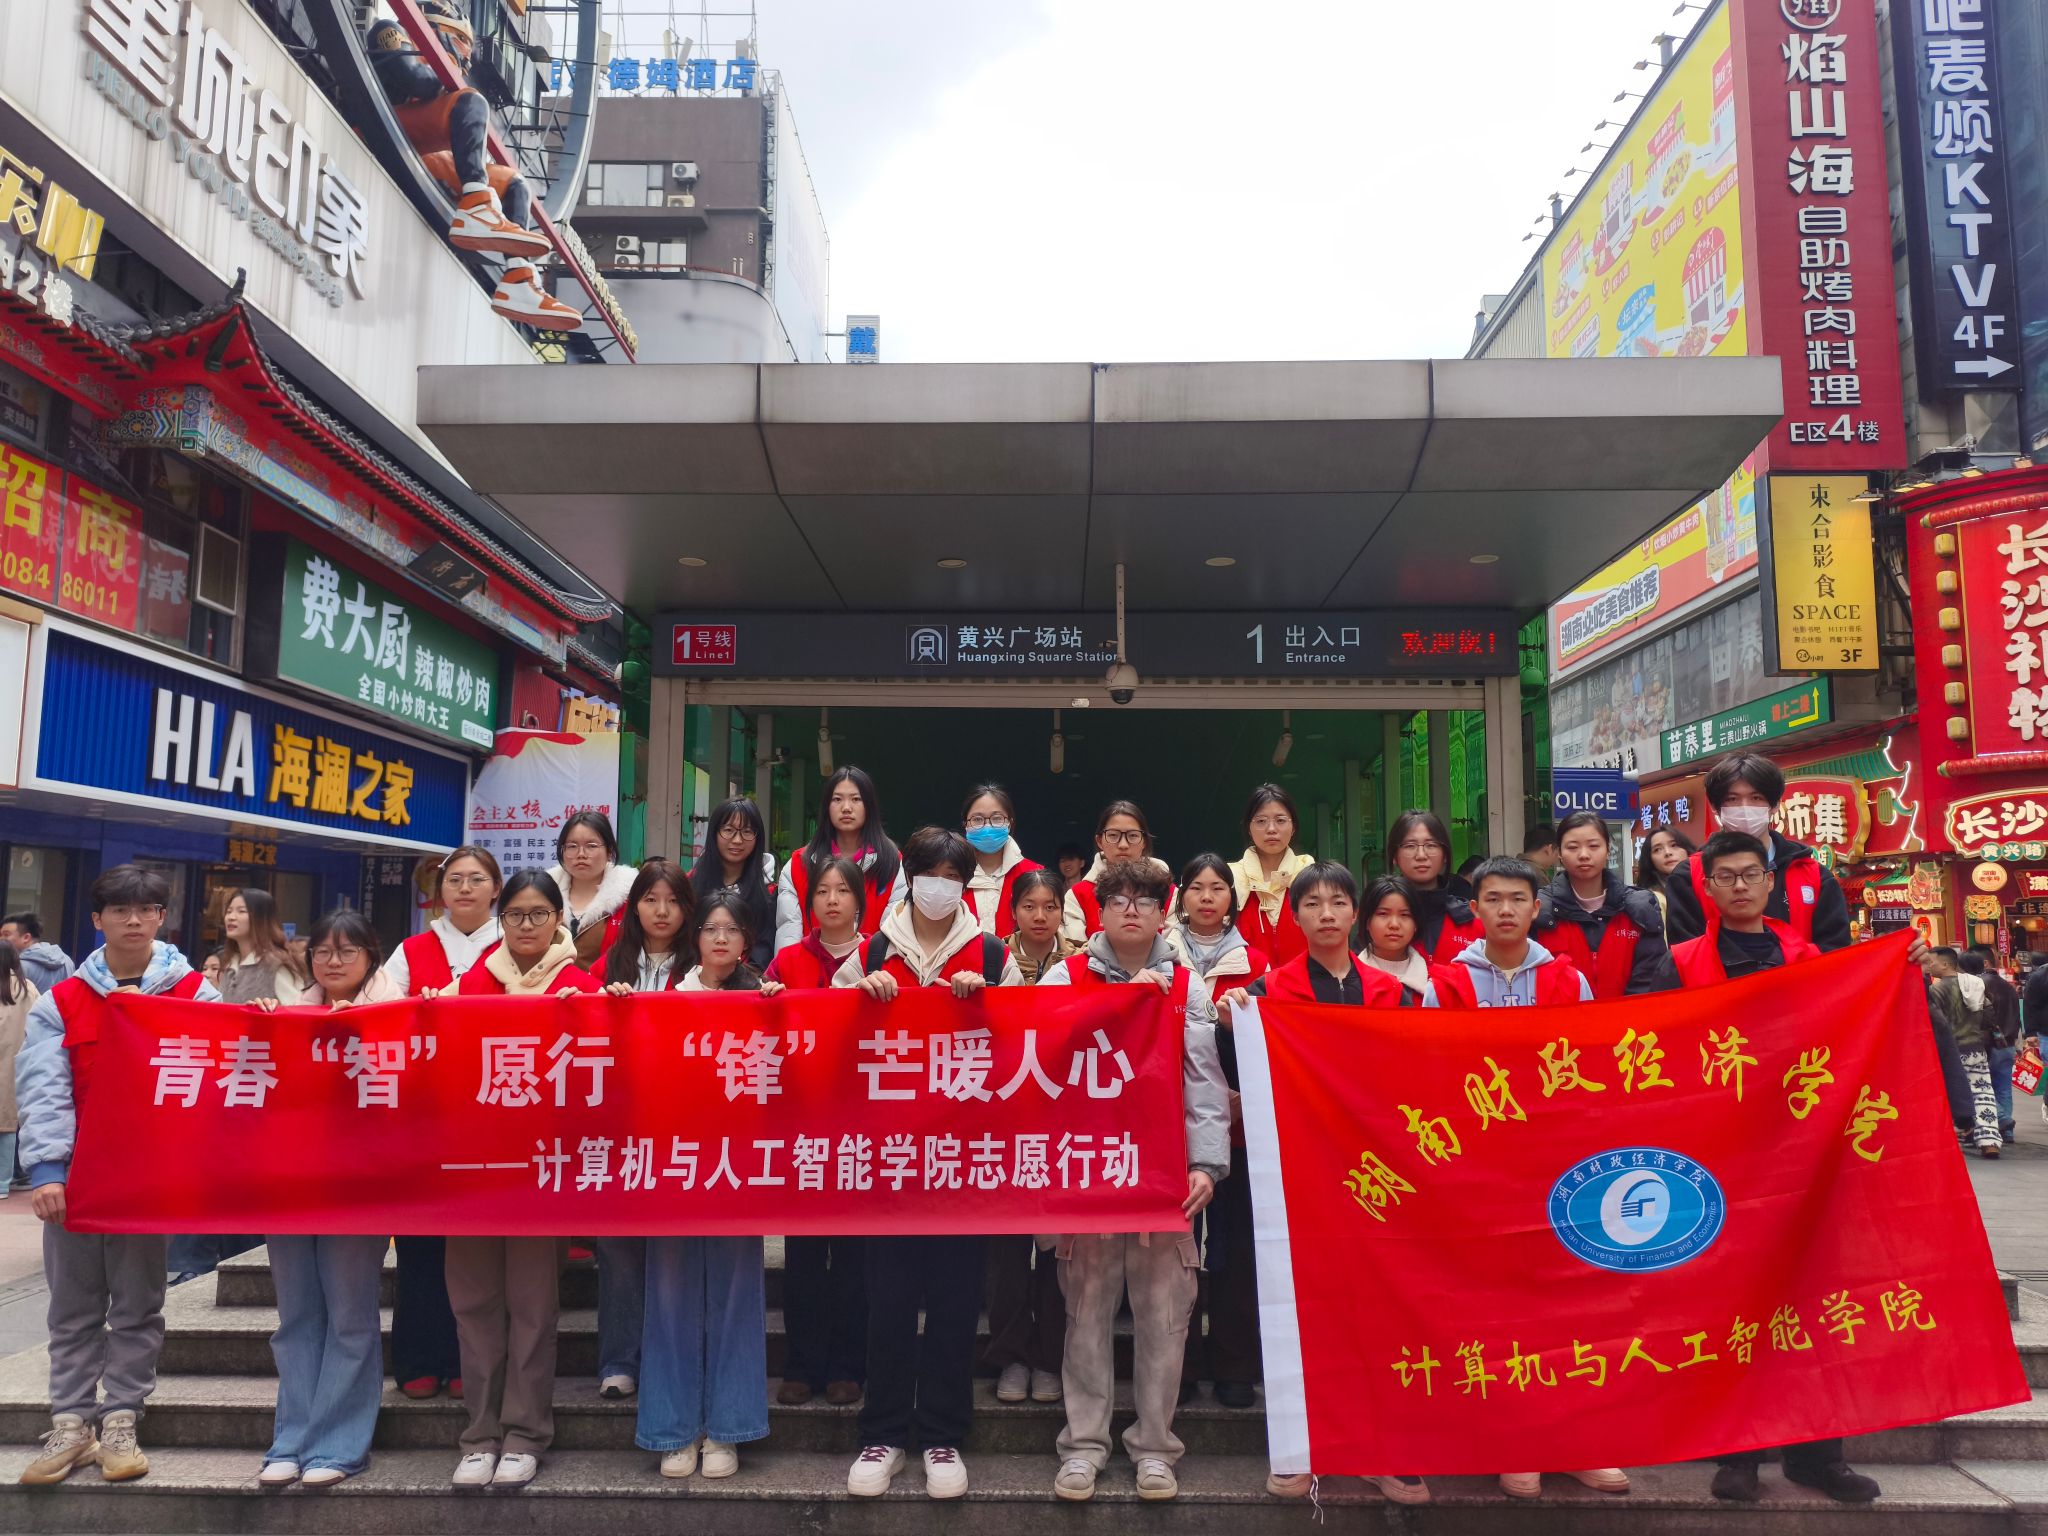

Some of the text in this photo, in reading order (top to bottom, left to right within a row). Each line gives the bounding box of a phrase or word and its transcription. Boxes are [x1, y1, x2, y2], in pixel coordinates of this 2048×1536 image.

[1953, 315, 2005, 349] 4F
[1789, 414, 1880, 444] E区4楼
[0, 550, 51, 590] 084
[62, 572, 119, 616] 86011
[1561, 569, 1658, 650] 湖南必吃美食推荐
[1793, 605, 1860, 620] SPACE
[301, 555, 412, 681] 费大厨
[414, 644, 490, 716] 辣椒炒肉
[957, 626, 1083, 649] 黄兴广场站
[1246, 624, 1361, 664] 1 出入口
[1286, 653, 1346, 663] Entrance
[1841, 649, 1862, 662] 3F
[957, 652, 1025, 665] Huangxing
[1028, 653, 1062, 665] Square
[358, 673, 450, 731] 全国小炒肉大王
[151, 687, 256, 797] HLA
[1667, 719, 1717, 764] 苗寨里
[1719, 720, 1767, 747] 云贵山野火锅
[269, 723, 414, 826] 海澜之家
[1554, 791, 1618, 811] OLICE
[1641, 796, 1691, 831] 酱板鸭
[1956, 799, 2048, 845] 长沙
[504, 839, 522, 847] 富强
[528, 839, 545, 847] 民主
[504, 853, 522, 861] 自由
[528, 853, 545, 861] 平等
[149, 1027, 1136, 1109] 青春 “智” 愿行 “锋” 芒暖人心
[1342, 1025, 1900, 1224] 湖南财政经济学院
[1555, 1152, 1706, 1203] 湖南财政经济学院
[1558, 1200, 1717, 1264] Hunan University of Finance and Economics
[1391, 1282, 1937, 1401] 计算机与人工智能学院
